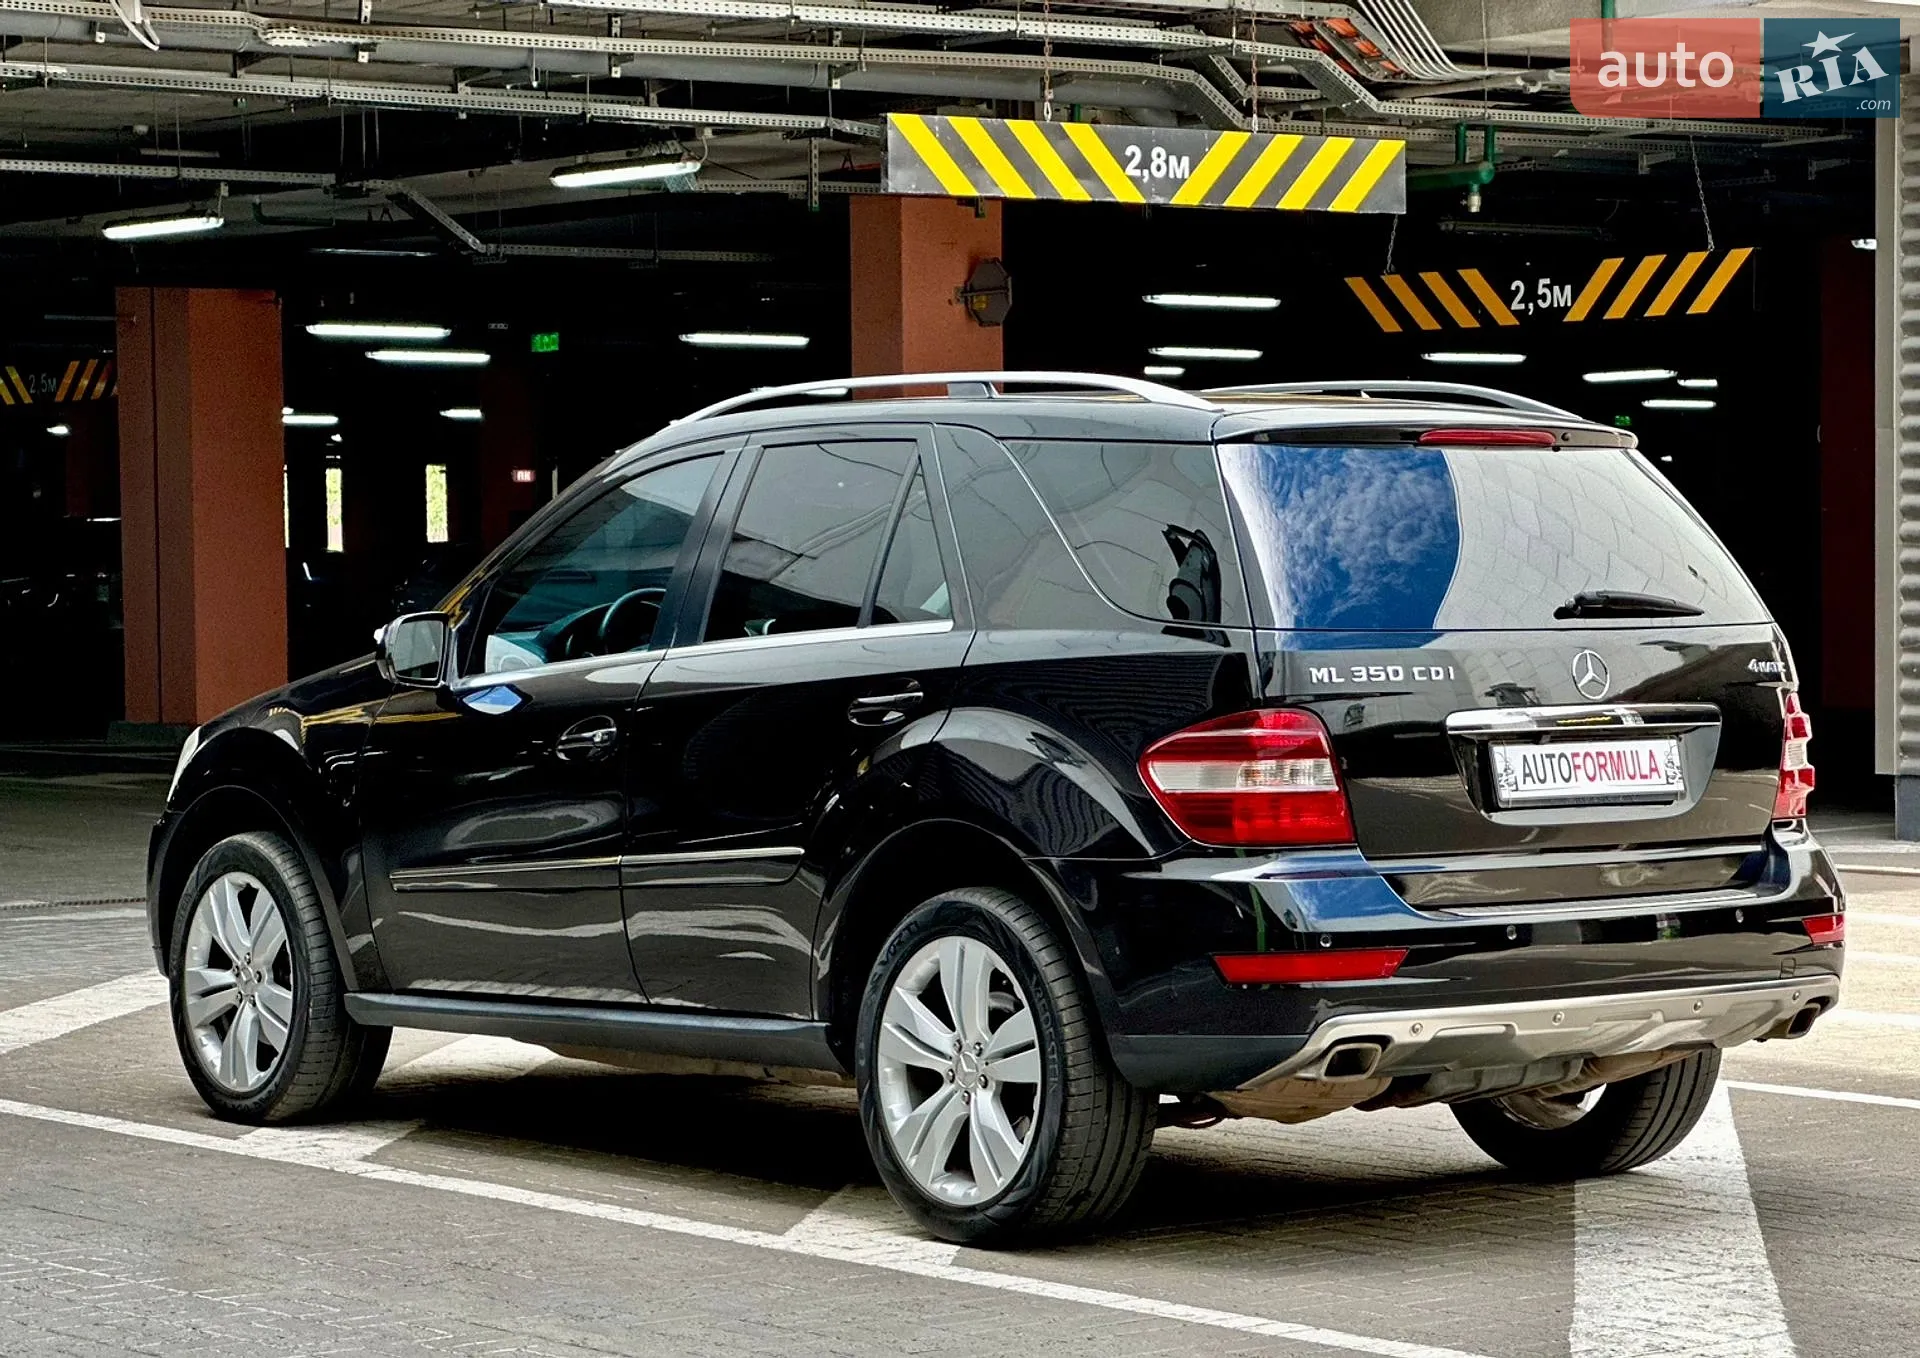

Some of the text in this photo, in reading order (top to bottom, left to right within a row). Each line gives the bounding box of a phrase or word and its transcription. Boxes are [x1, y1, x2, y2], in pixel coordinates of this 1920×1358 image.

[1309, 665, 1456, 684] ML 350 CDI
[1521, 748, 1662, 786] AUTOFORMULA
